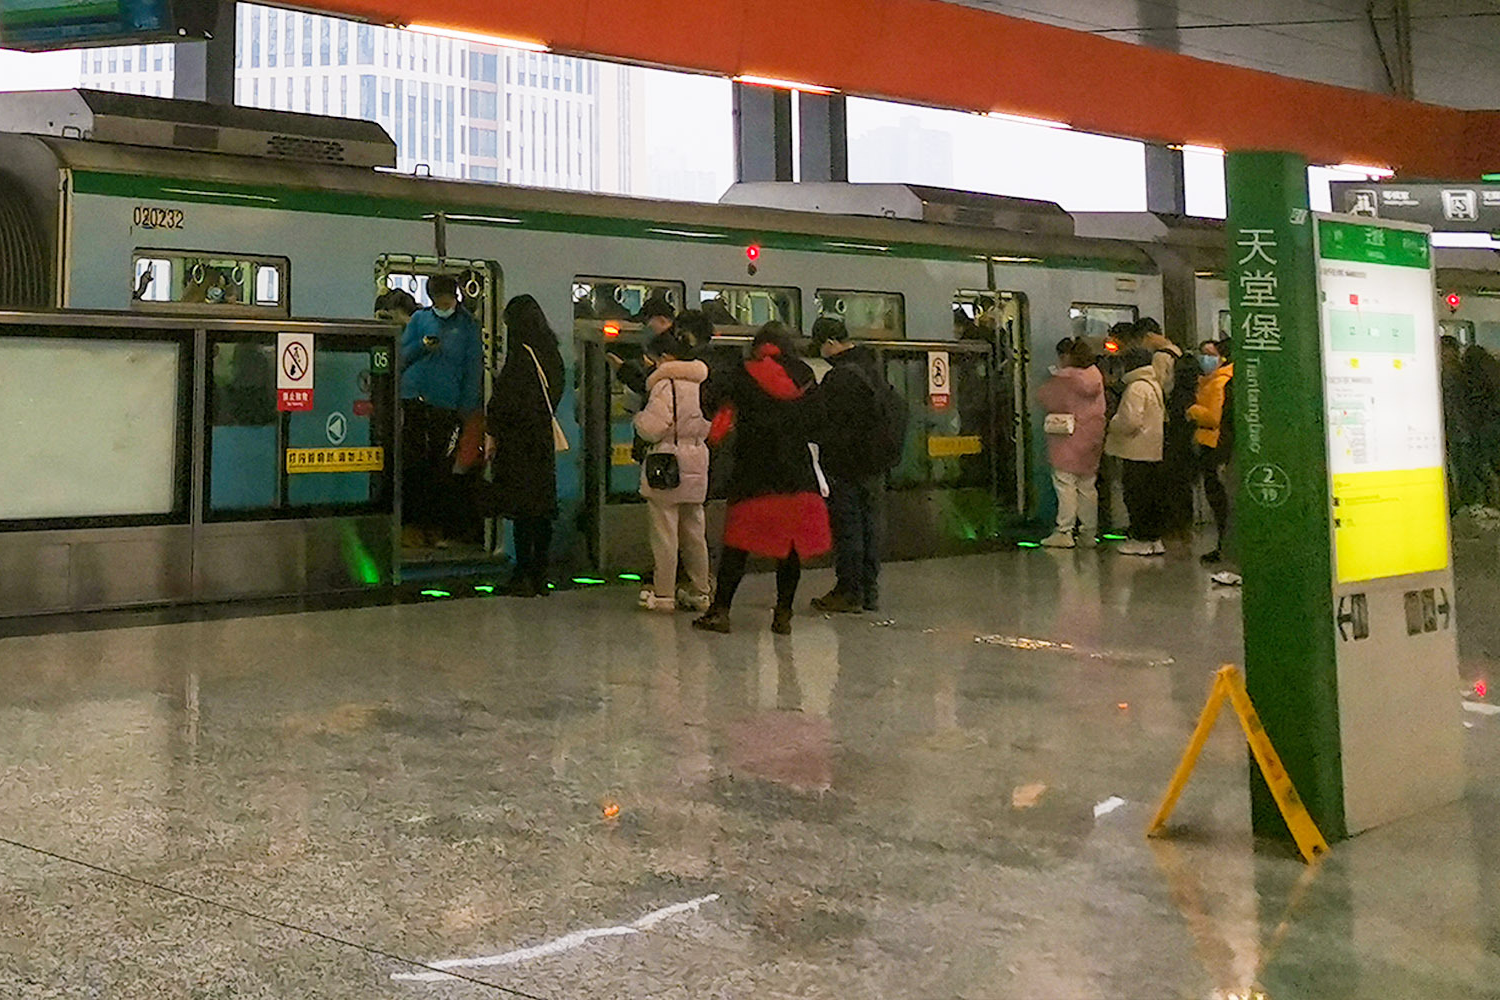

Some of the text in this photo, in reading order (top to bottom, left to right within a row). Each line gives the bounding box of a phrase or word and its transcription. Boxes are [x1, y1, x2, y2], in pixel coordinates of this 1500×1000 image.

[133, 206, 184, 229] 020232
[1237, 229, 1282, 350] 天堂堡
[375, 352, 388, 367] 05
[1262, 467, 1275, 484] 2
